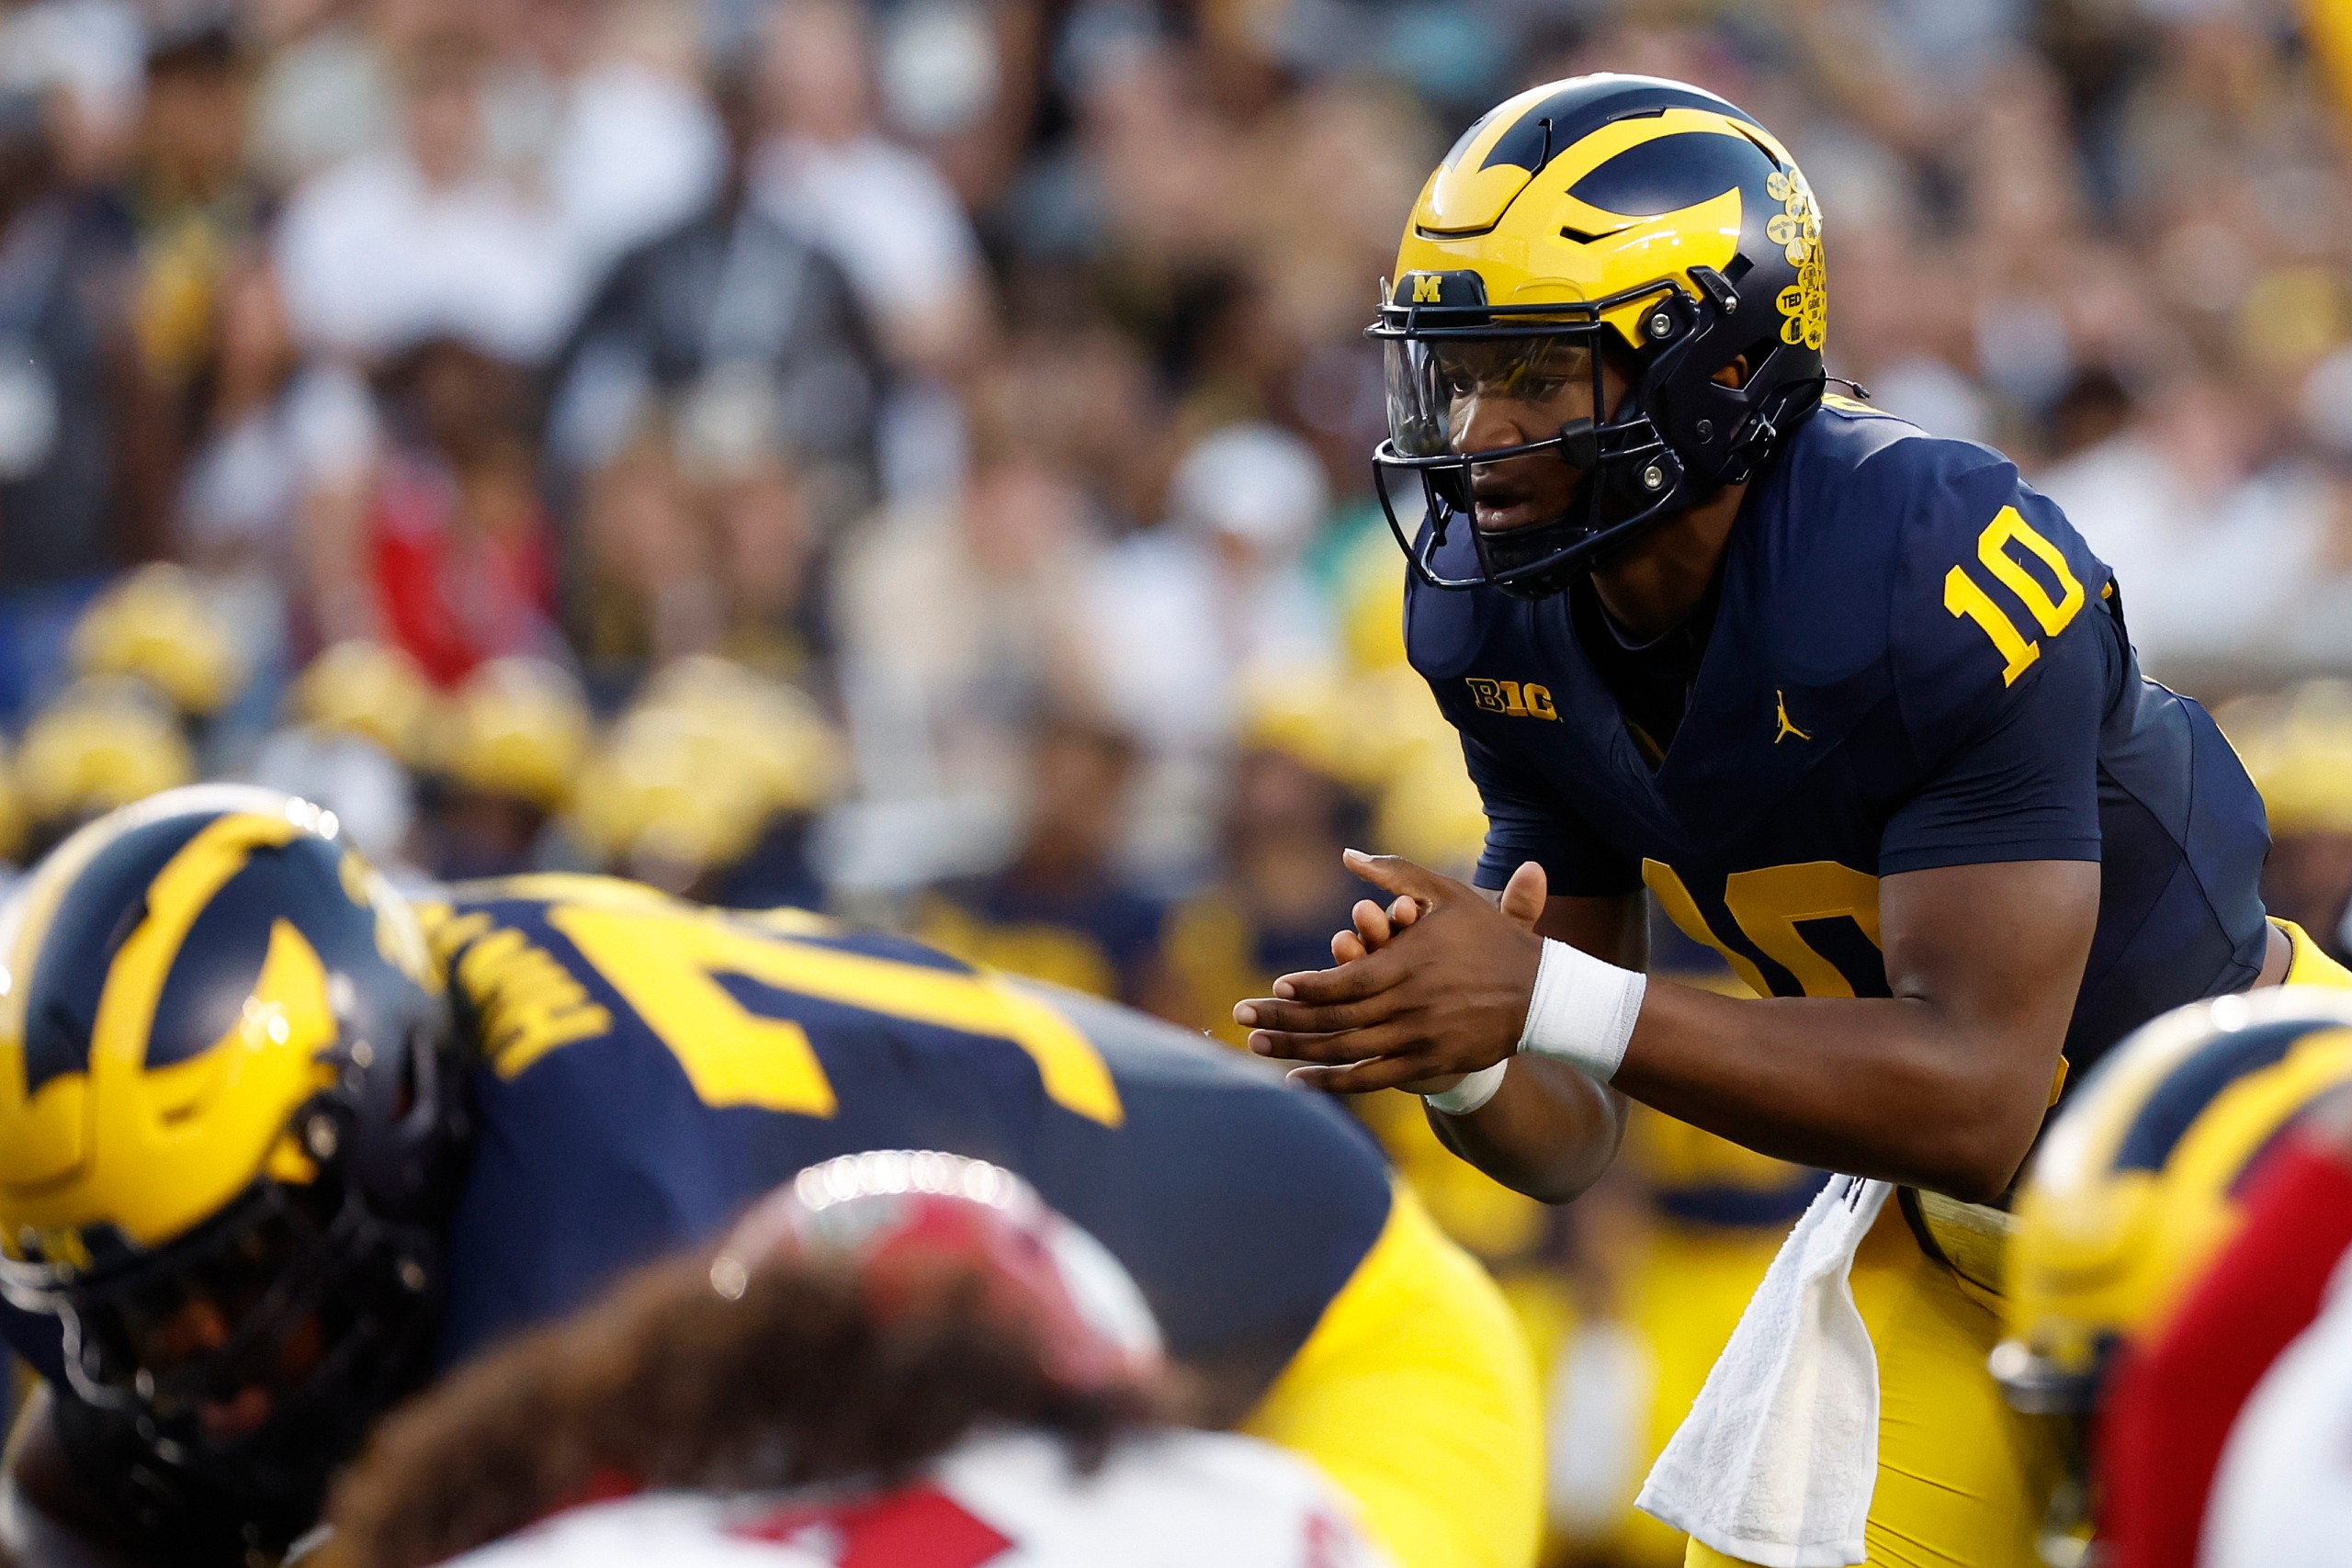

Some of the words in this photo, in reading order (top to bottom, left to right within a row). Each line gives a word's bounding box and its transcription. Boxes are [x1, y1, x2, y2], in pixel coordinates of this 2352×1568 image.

[1412, 276, 1442, 302] M
[1781, 292, 1802, 309] TED
[1944, 505, 2085, 688] 10
[514, 874, 1125, 1128] 7
